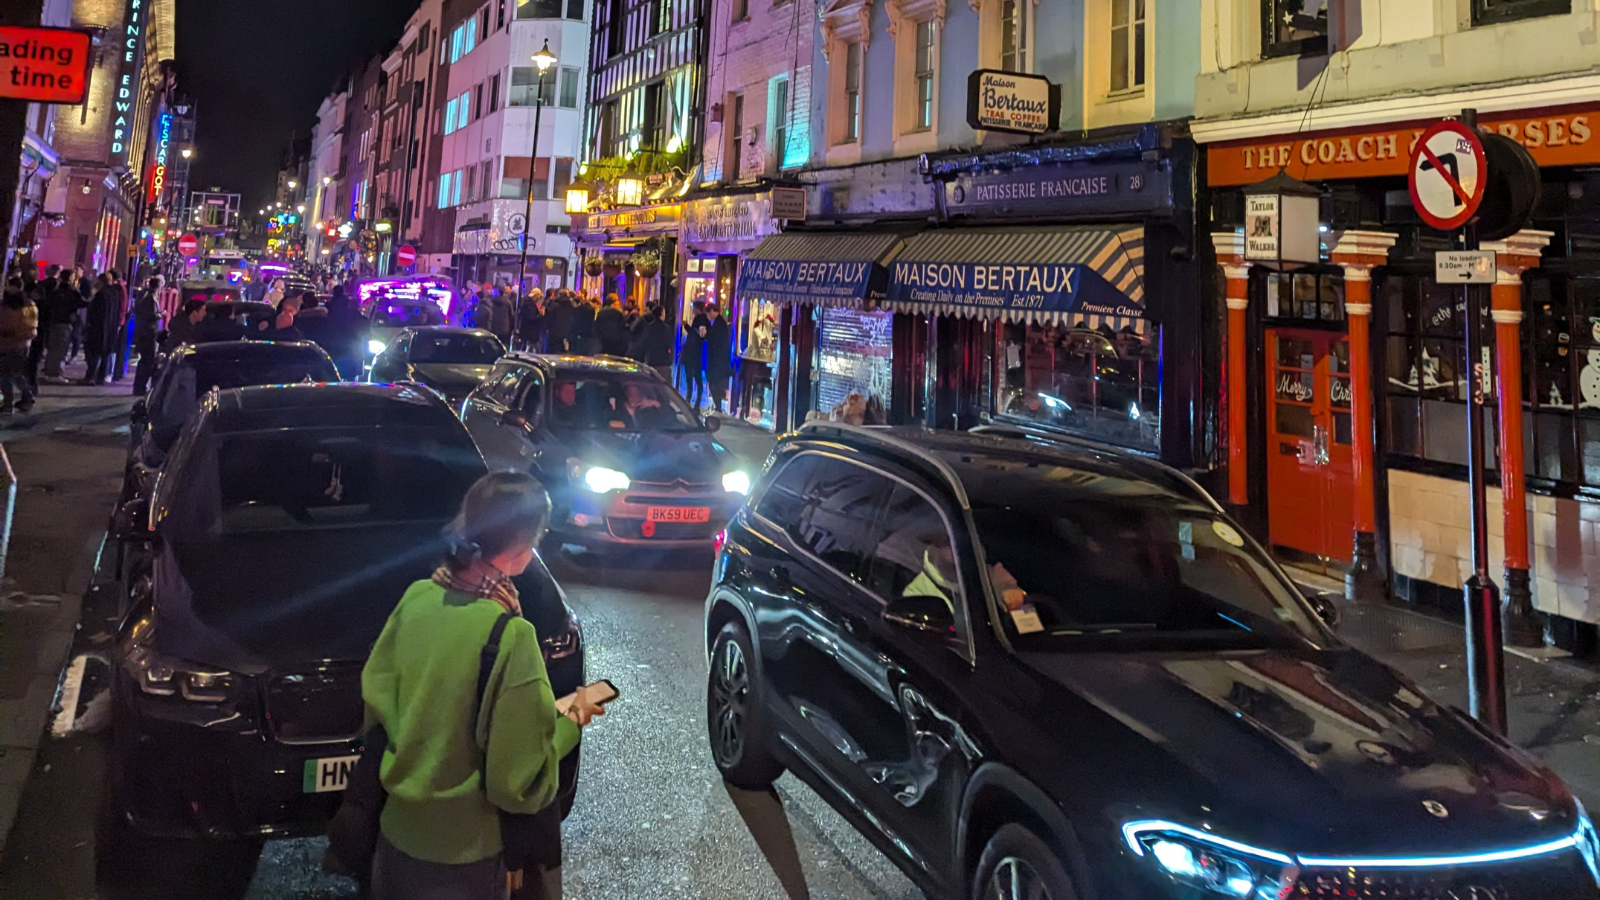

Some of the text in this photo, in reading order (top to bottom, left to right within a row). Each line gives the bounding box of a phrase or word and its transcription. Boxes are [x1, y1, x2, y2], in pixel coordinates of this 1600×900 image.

[10, 65, 73, 90] time
[982, 75, 1016, 89] Maison
[982, 86, 1046, 114] Bertaux
[112, 74, 131, 153] EDWARD
[985, 109, 1041, 123] TEAS COFFEE
[1242, 143, 1292, 170] THE
[1300, 134, 1398, 166] COACH
[977, 183, 1036, 200] PATISSERIE
[1129, 176, 1140, 189] 28
[1250, 200, 1275, 212] TAYLOR
[745, 261, 867, 283] MAISON BERTAUX
[894, 263, 1075, 294] MAISON BERTAUX
[910, 288, 937, 302] Creating
[955, 293, 963, 302] on
[964, 292, 974, 303] the
[975, 293, 1004, 306] Premises
[1116, 305, 1143, 317] Classe
[1276, 374, 1313, 402] Merry
[652, 508, 704, 521] BK59 UEC
[321, 760, 356, 787] HN
